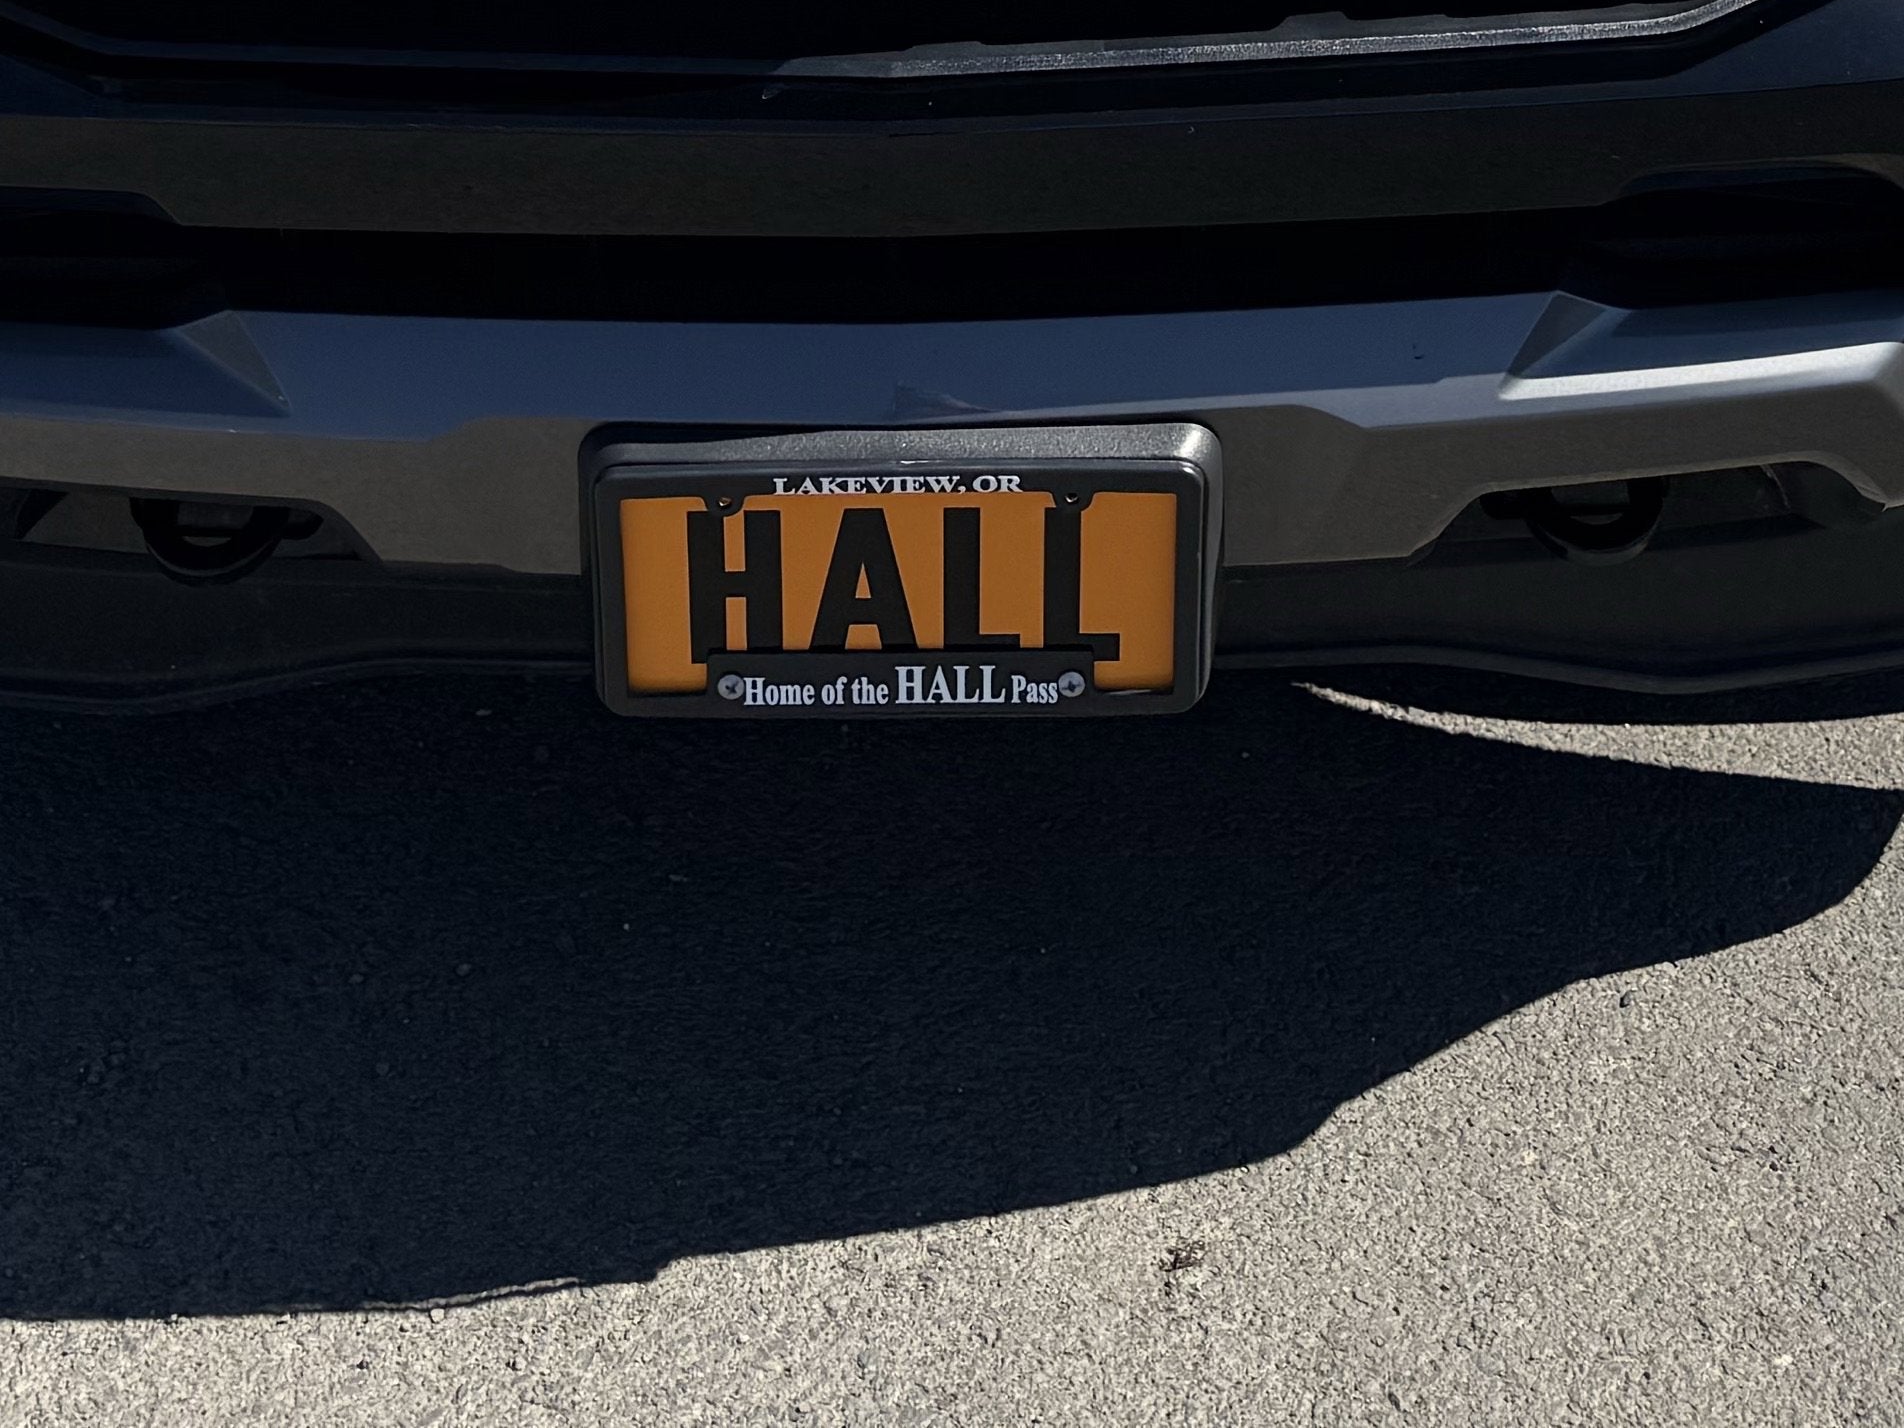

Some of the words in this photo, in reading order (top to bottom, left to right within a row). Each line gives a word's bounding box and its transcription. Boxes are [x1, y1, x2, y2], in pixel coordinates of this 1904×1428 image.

[773, 475, 966, 495] LAKEVIEW,
[972, 475, 1024, 493] OR
[686, 506, 1121, 665] HALL
[743, 676, 815, 706] Home
[821, 676, 848, 706] of
[851, 675, 889, 705] the
[895, 664, 1006, 704] HALL
[1011, 674, 1059, 704] Pass
